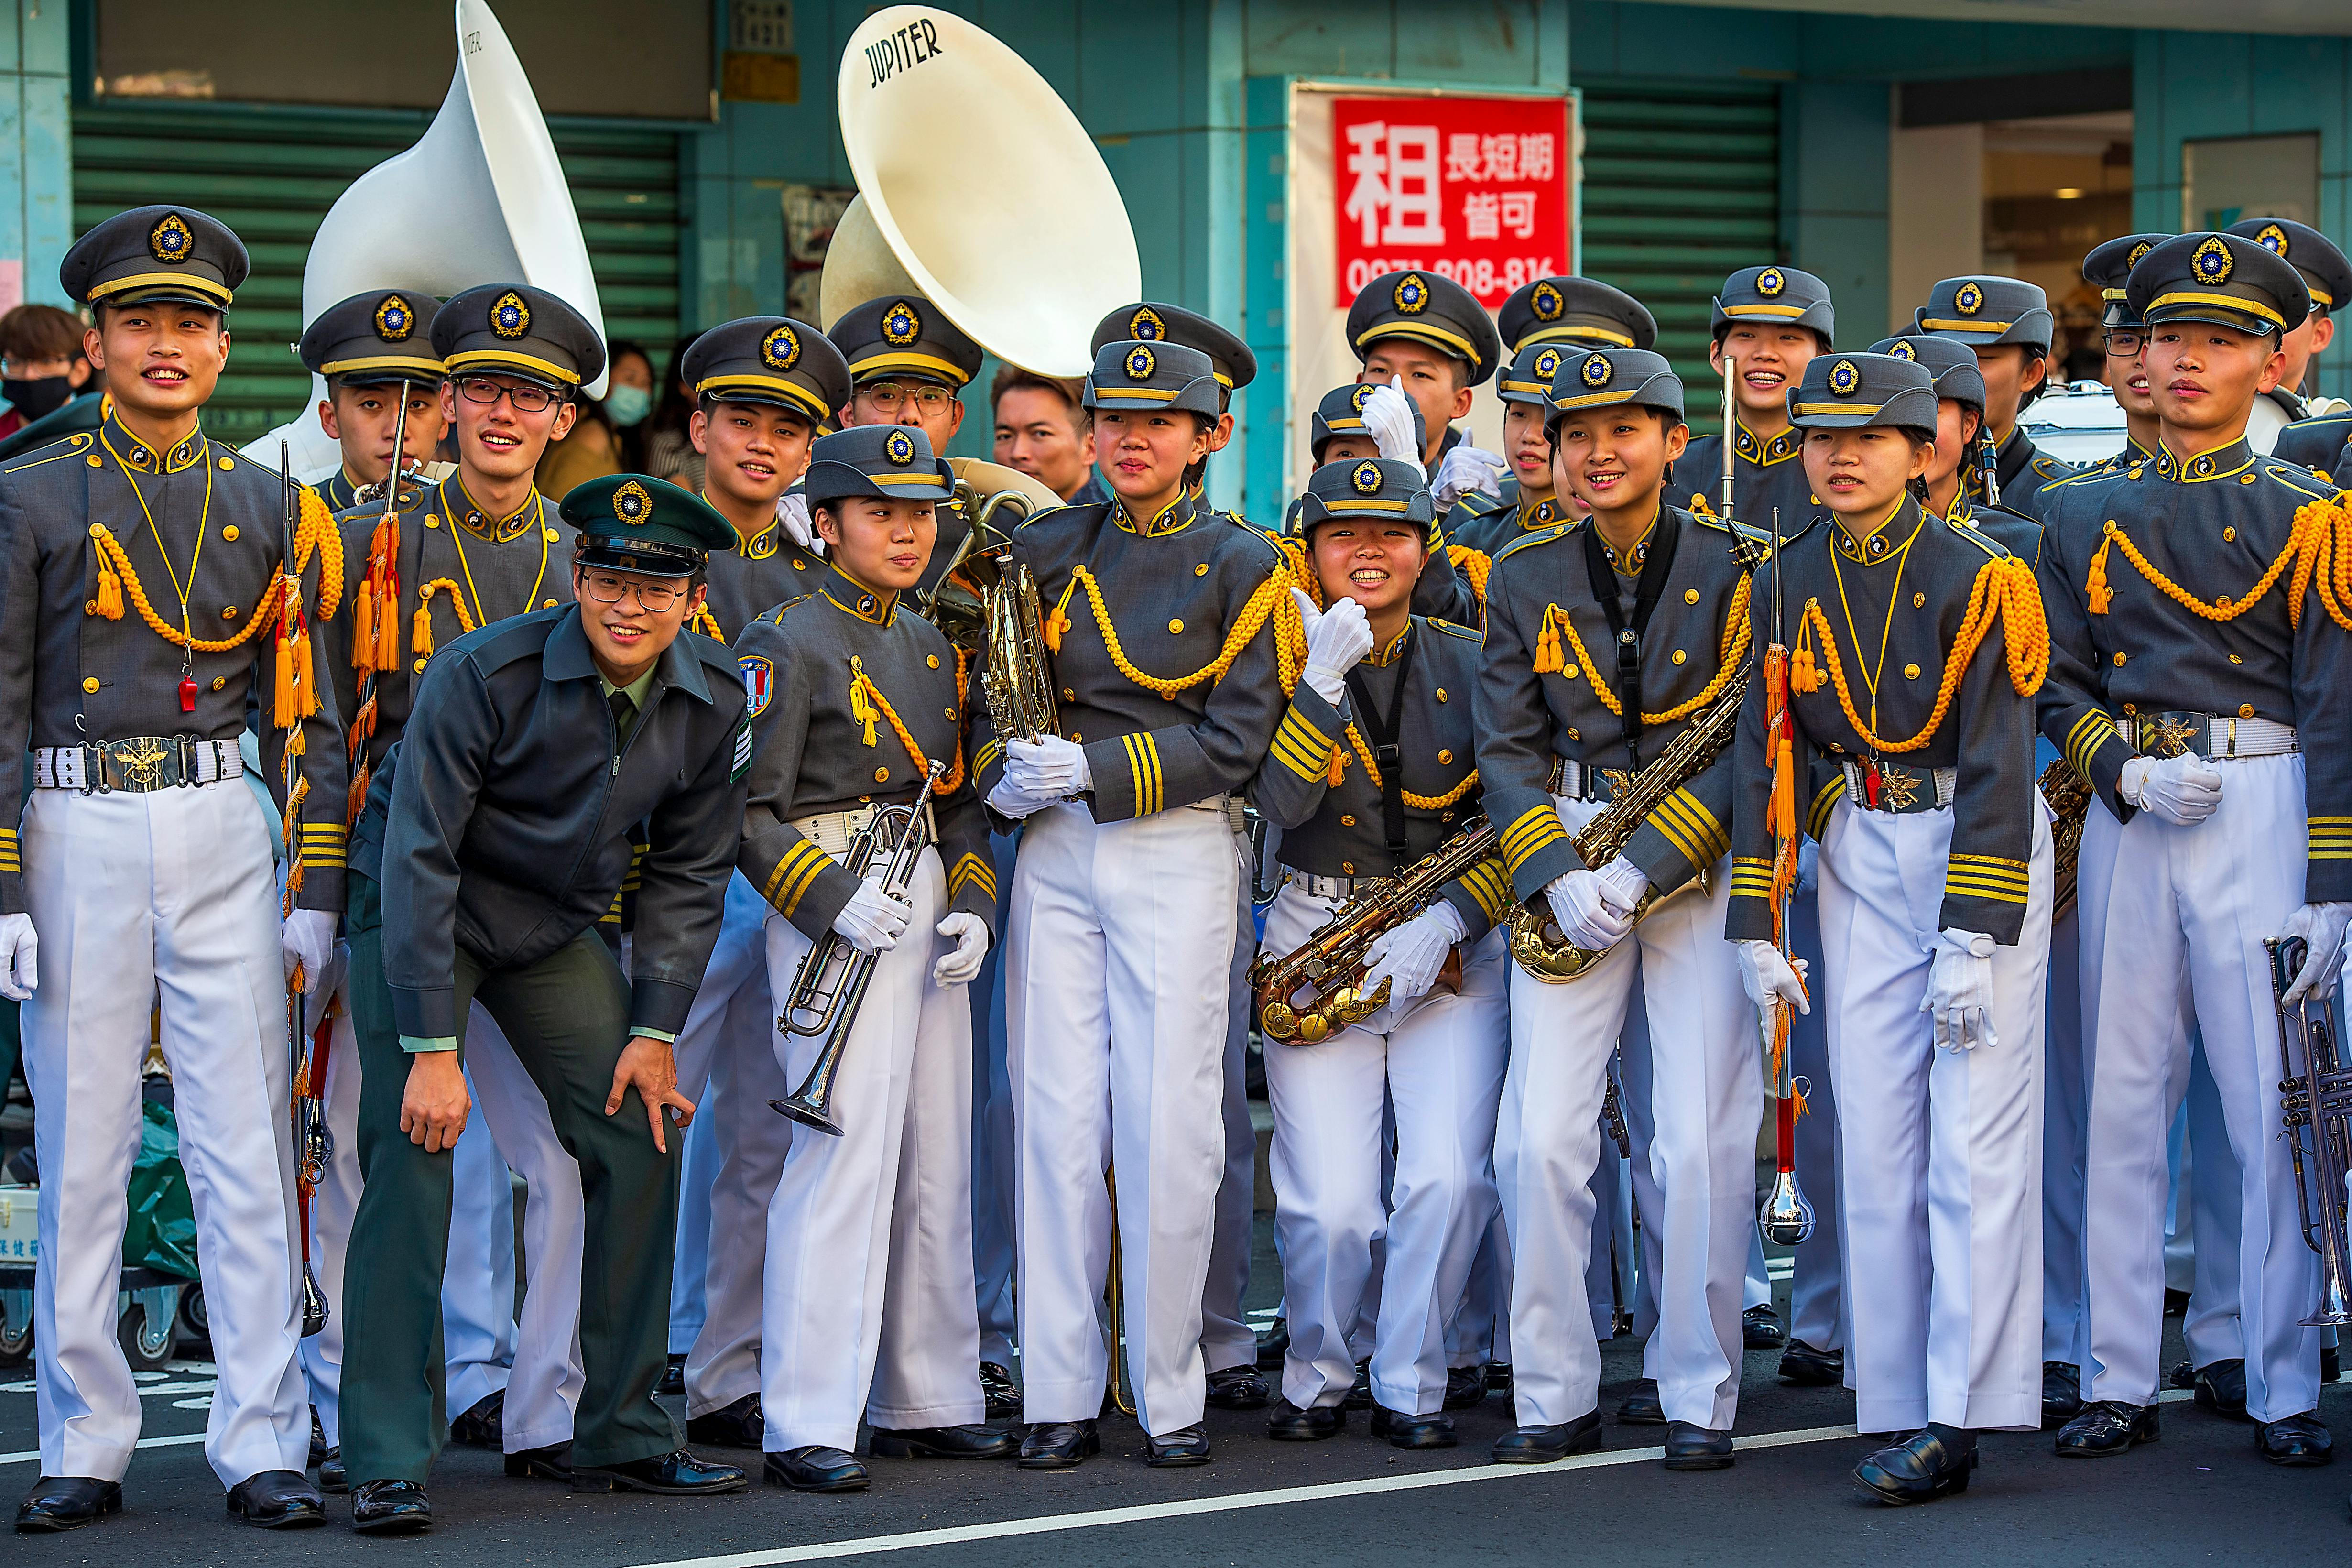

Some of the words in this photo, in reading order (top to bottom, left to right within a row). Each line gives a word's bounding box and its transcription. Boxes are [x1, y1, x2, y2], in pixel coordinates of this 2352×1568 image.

[865, 19, 942, 89] JUPITER
[1345, 120, 1446, 248] 租
[1445, 132, 1555, 182] 長短期
[1462, 191, 1538, 241] 皆可
